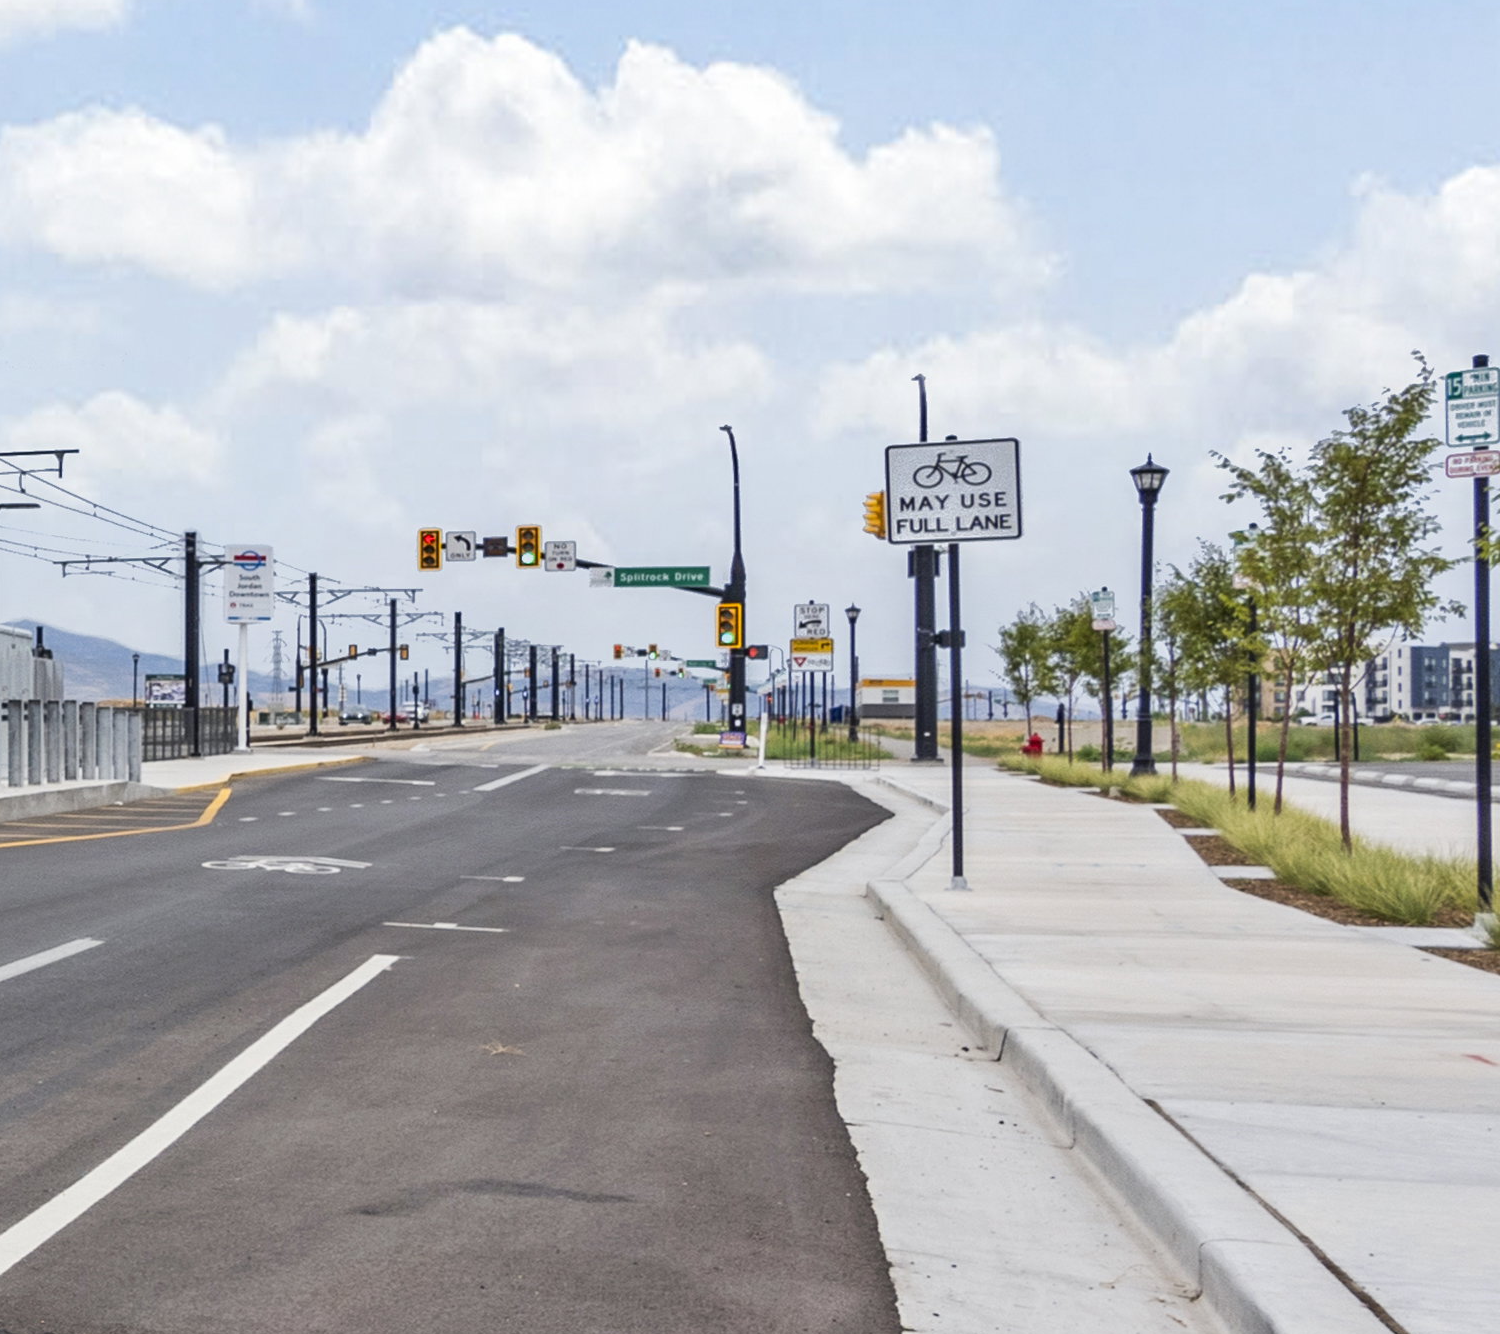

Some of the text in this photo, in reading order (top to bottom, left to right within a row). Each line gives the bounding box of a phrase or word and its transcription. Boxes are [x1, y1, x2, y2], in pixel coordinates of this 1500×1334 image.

[1448, 377, 1462, 396] 15
[1463, 382, 1498, 395] PARKING
[900, 491, 1008, 513] MAY USE
[896, 513, 1013, 535] FULL LANE
[620, 572, 670, 584] Splitrock
[674, 572, 704, 582] Drive
[806, 628, 826, 636] RED
